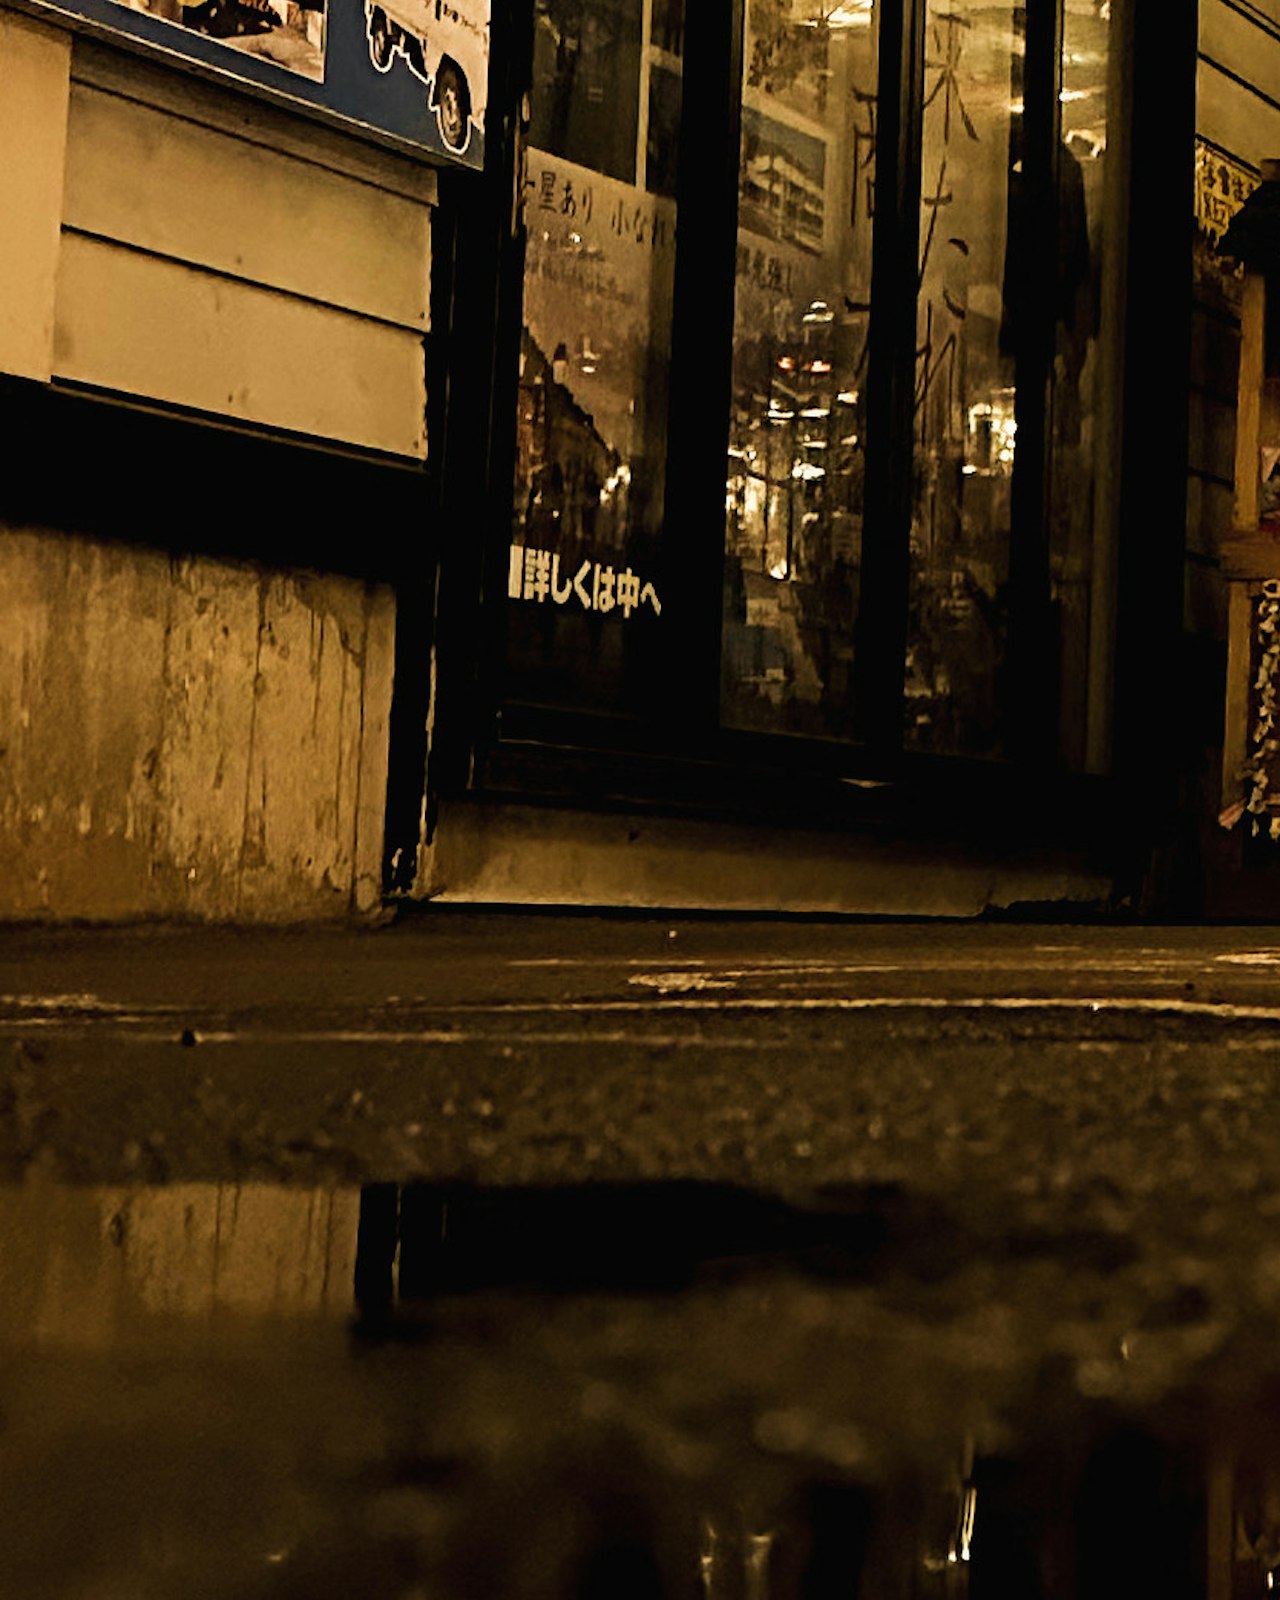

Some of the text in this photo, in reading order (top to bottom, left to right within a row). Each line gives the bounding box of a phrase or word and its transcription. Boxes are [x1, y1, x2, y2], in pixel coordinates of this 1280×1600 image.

[523, 547, 662, 618] 詳しくは中へ
